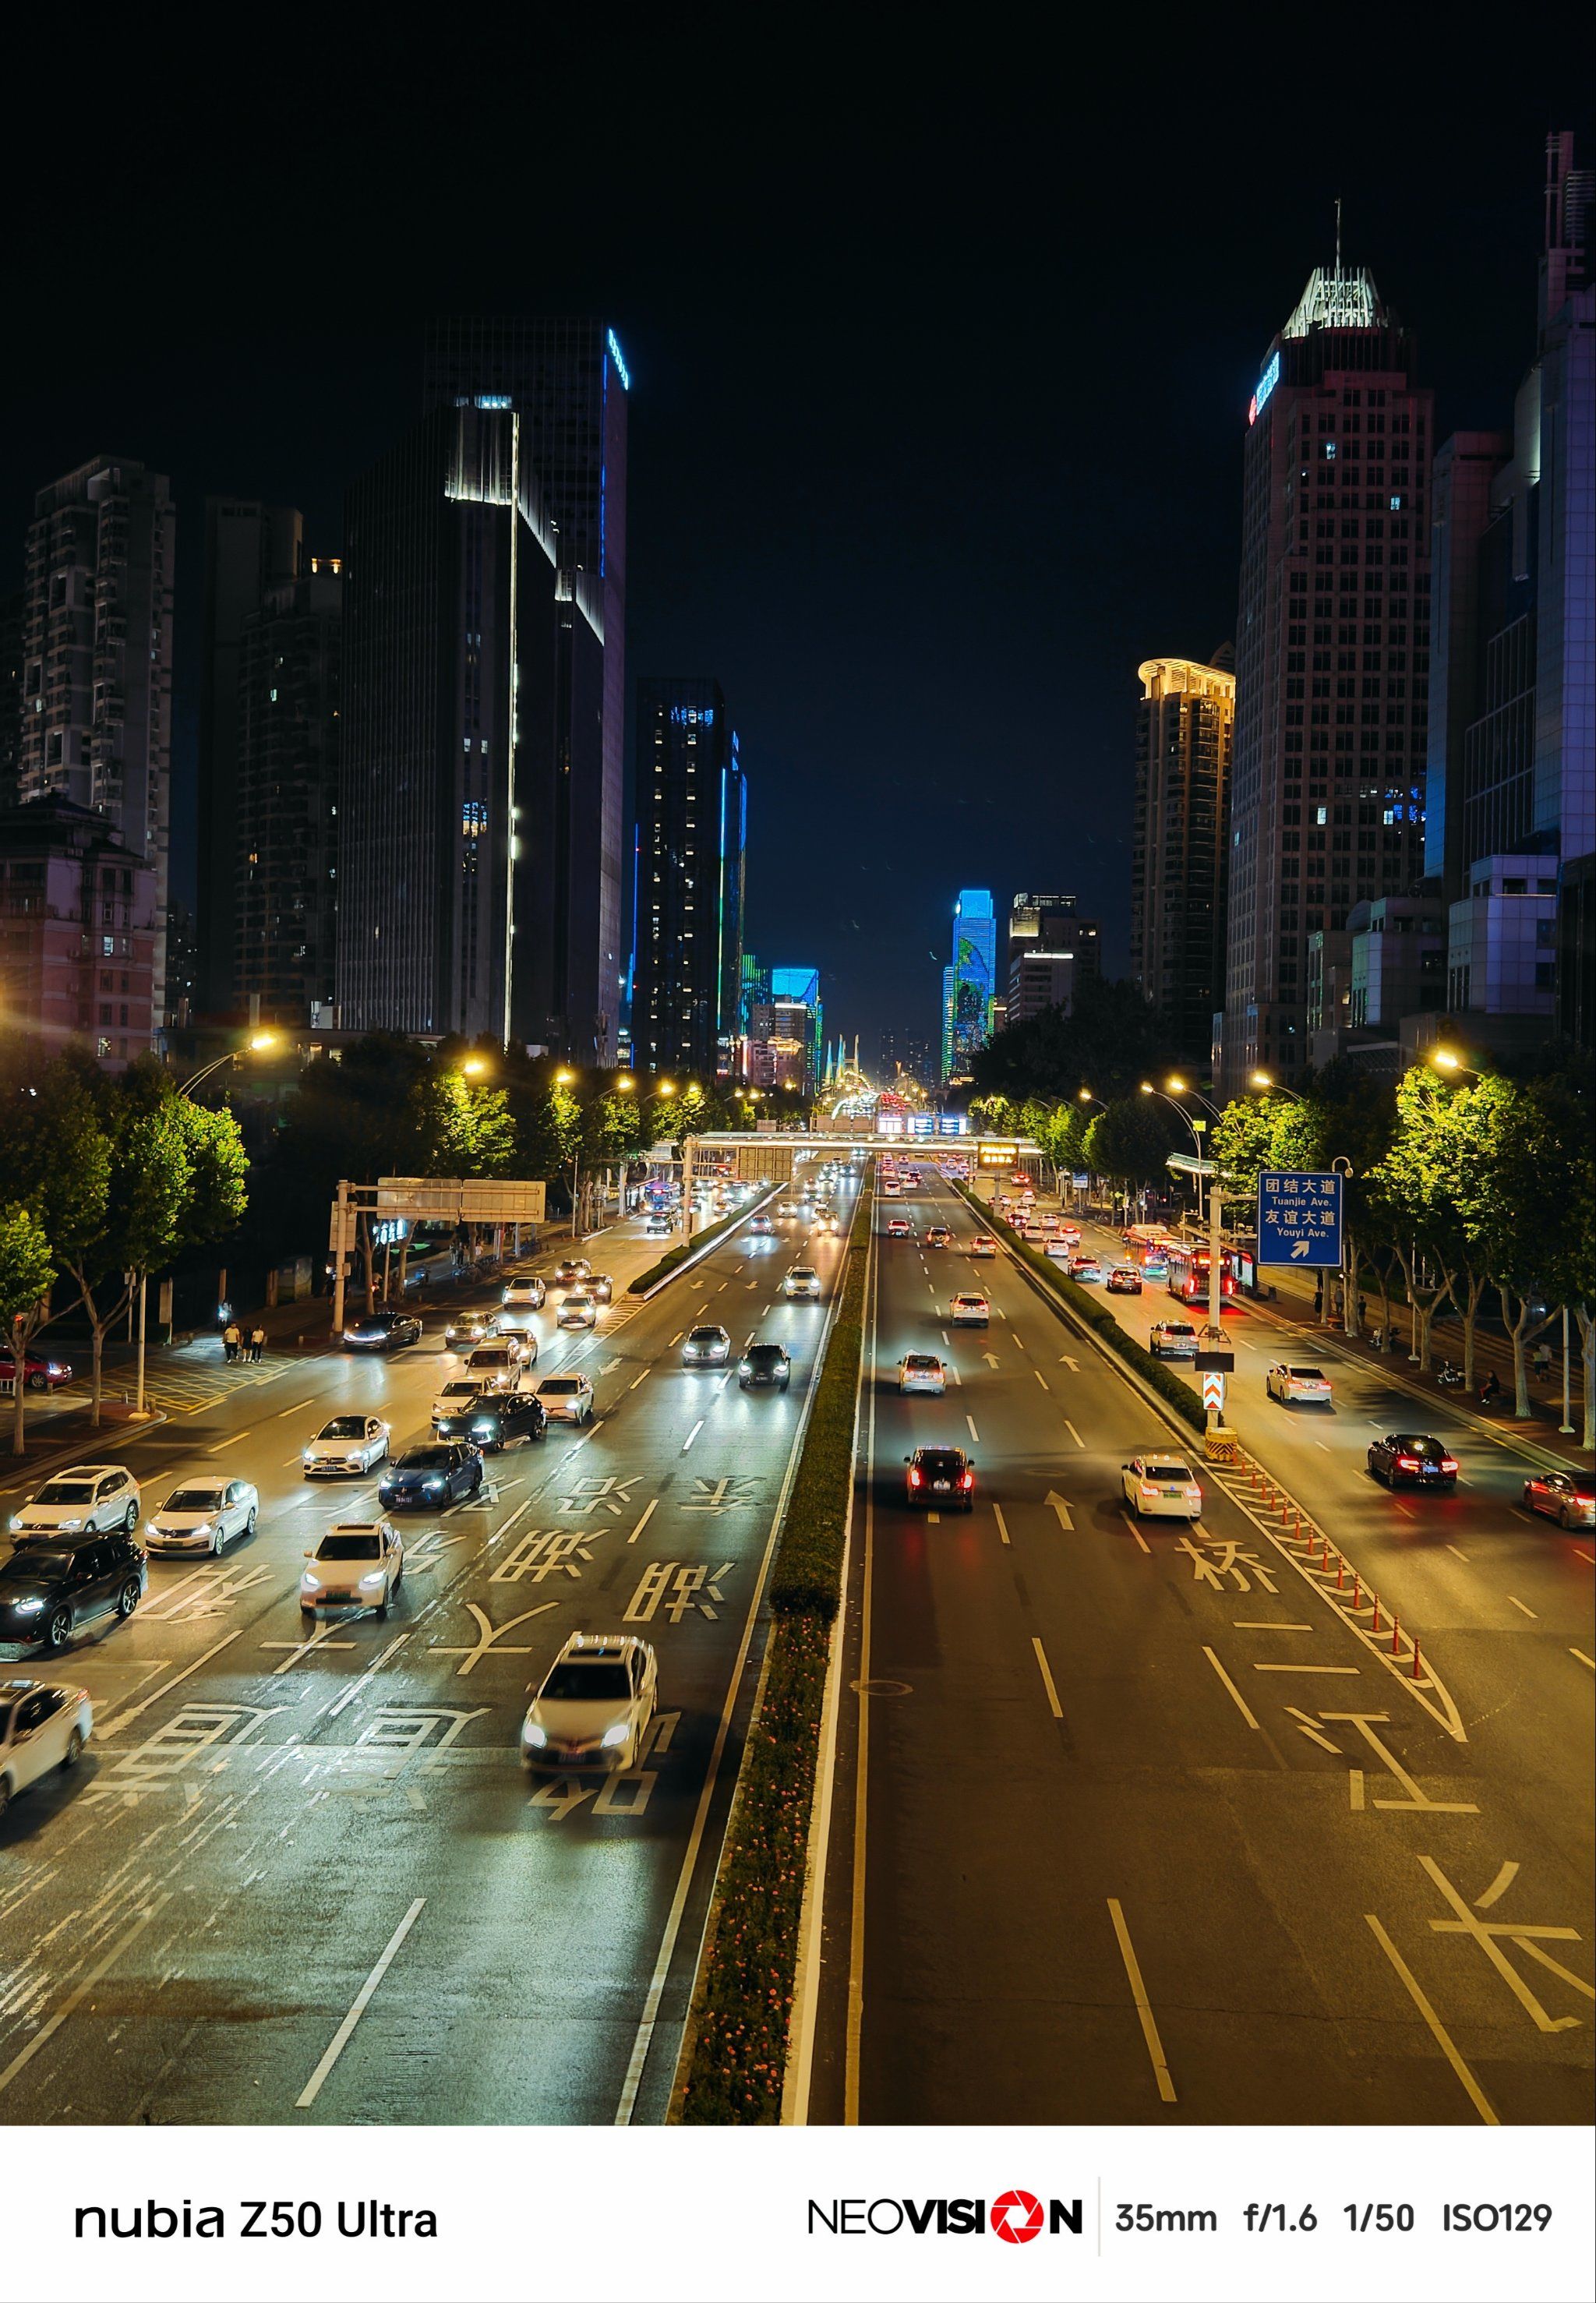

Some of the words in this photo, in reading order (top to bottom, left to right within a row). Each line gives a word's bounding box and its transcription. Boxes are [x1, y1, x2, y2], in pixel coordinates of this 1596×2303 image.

[1266, 1178, 1335, 1195] 团结大道
[1271, 1196, 1306, 1206] Tuanjie
[1311, 1197, 1332, 1206] Ave.
[1265, 1209, 1335, 1226] 友谊大道
[1276, 1227, 1304, 1238] Youyi
[1308, 1228, 1329, 1238] Ave.
